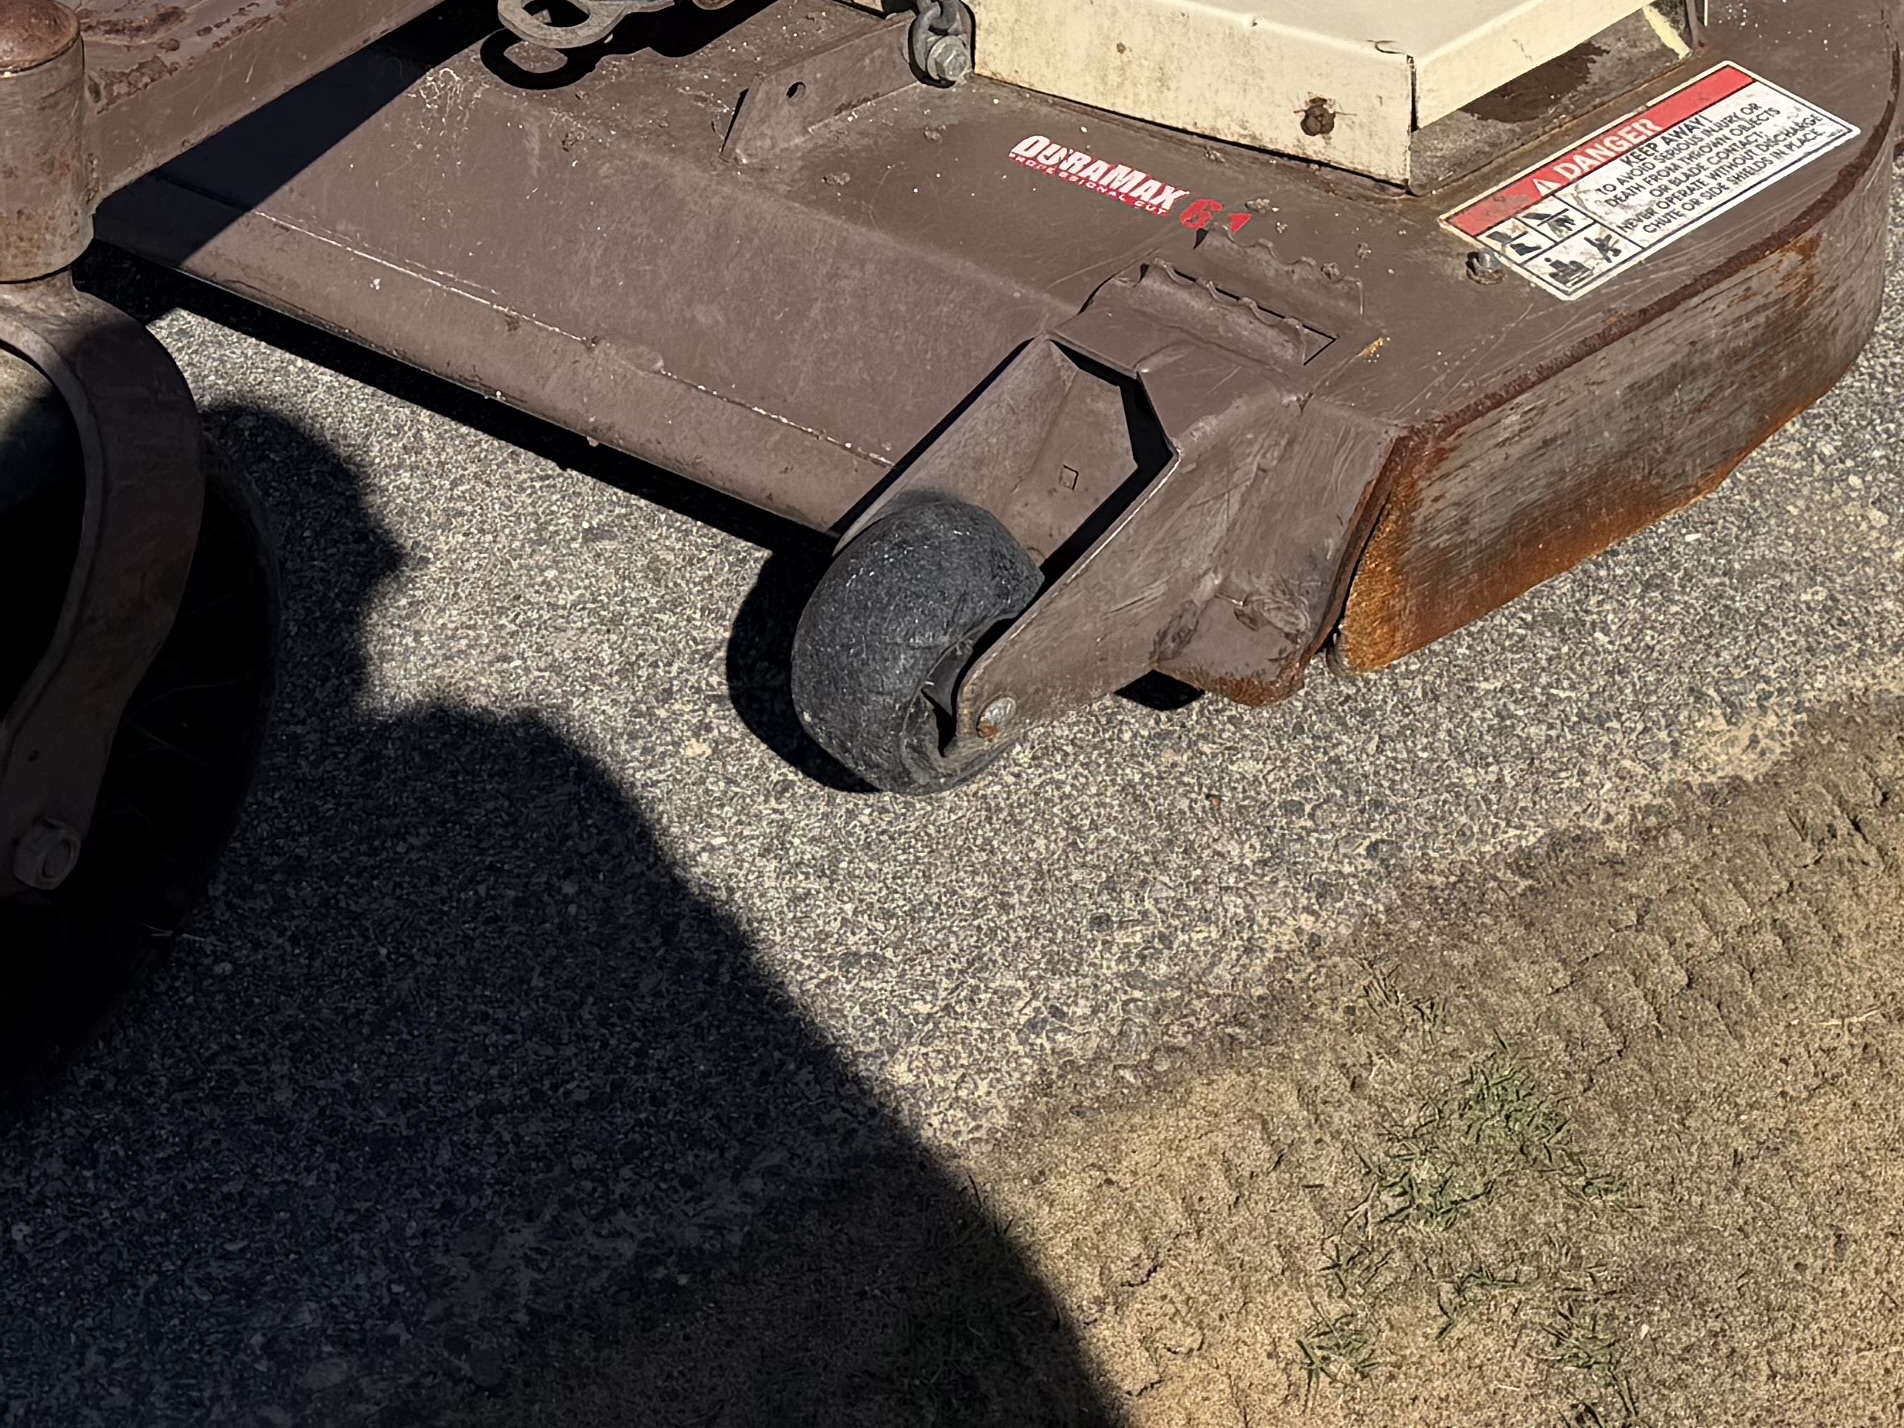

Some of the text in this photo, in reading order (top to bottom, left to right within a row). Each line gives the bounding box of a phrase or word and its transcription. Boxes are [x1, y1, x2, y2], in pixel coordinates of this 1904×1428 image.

[1010, 135, 1191, 210] DURAMAX
[1553, 118, 1663, 181] DANGER
[1596, 103, 1762, 195] TO AVOID SERIOUS INJURY OR
[1604, 107, 1780, 207] DEATH FROM THROWN OBJECTS
[1616, 114, 1823, 233] NEVER OPERATE WITHOUT DISCHARGE
[1619, 114, 1713, 167] KEEP AWAY!
[1134, 200, 1170, 217] CUT
[1642, 208, 1686, 233] CHUTE
[1681, 197, 1704, 211] OR
[1699, 182, 1730, 200] SIDE
[1727, 156, 1774, 185] SHIELDS
[1769, 148, 1791, 160] IN
[1649, 183, 1673, 197] OR
[1668, 162, 1710, 187] BLADE
